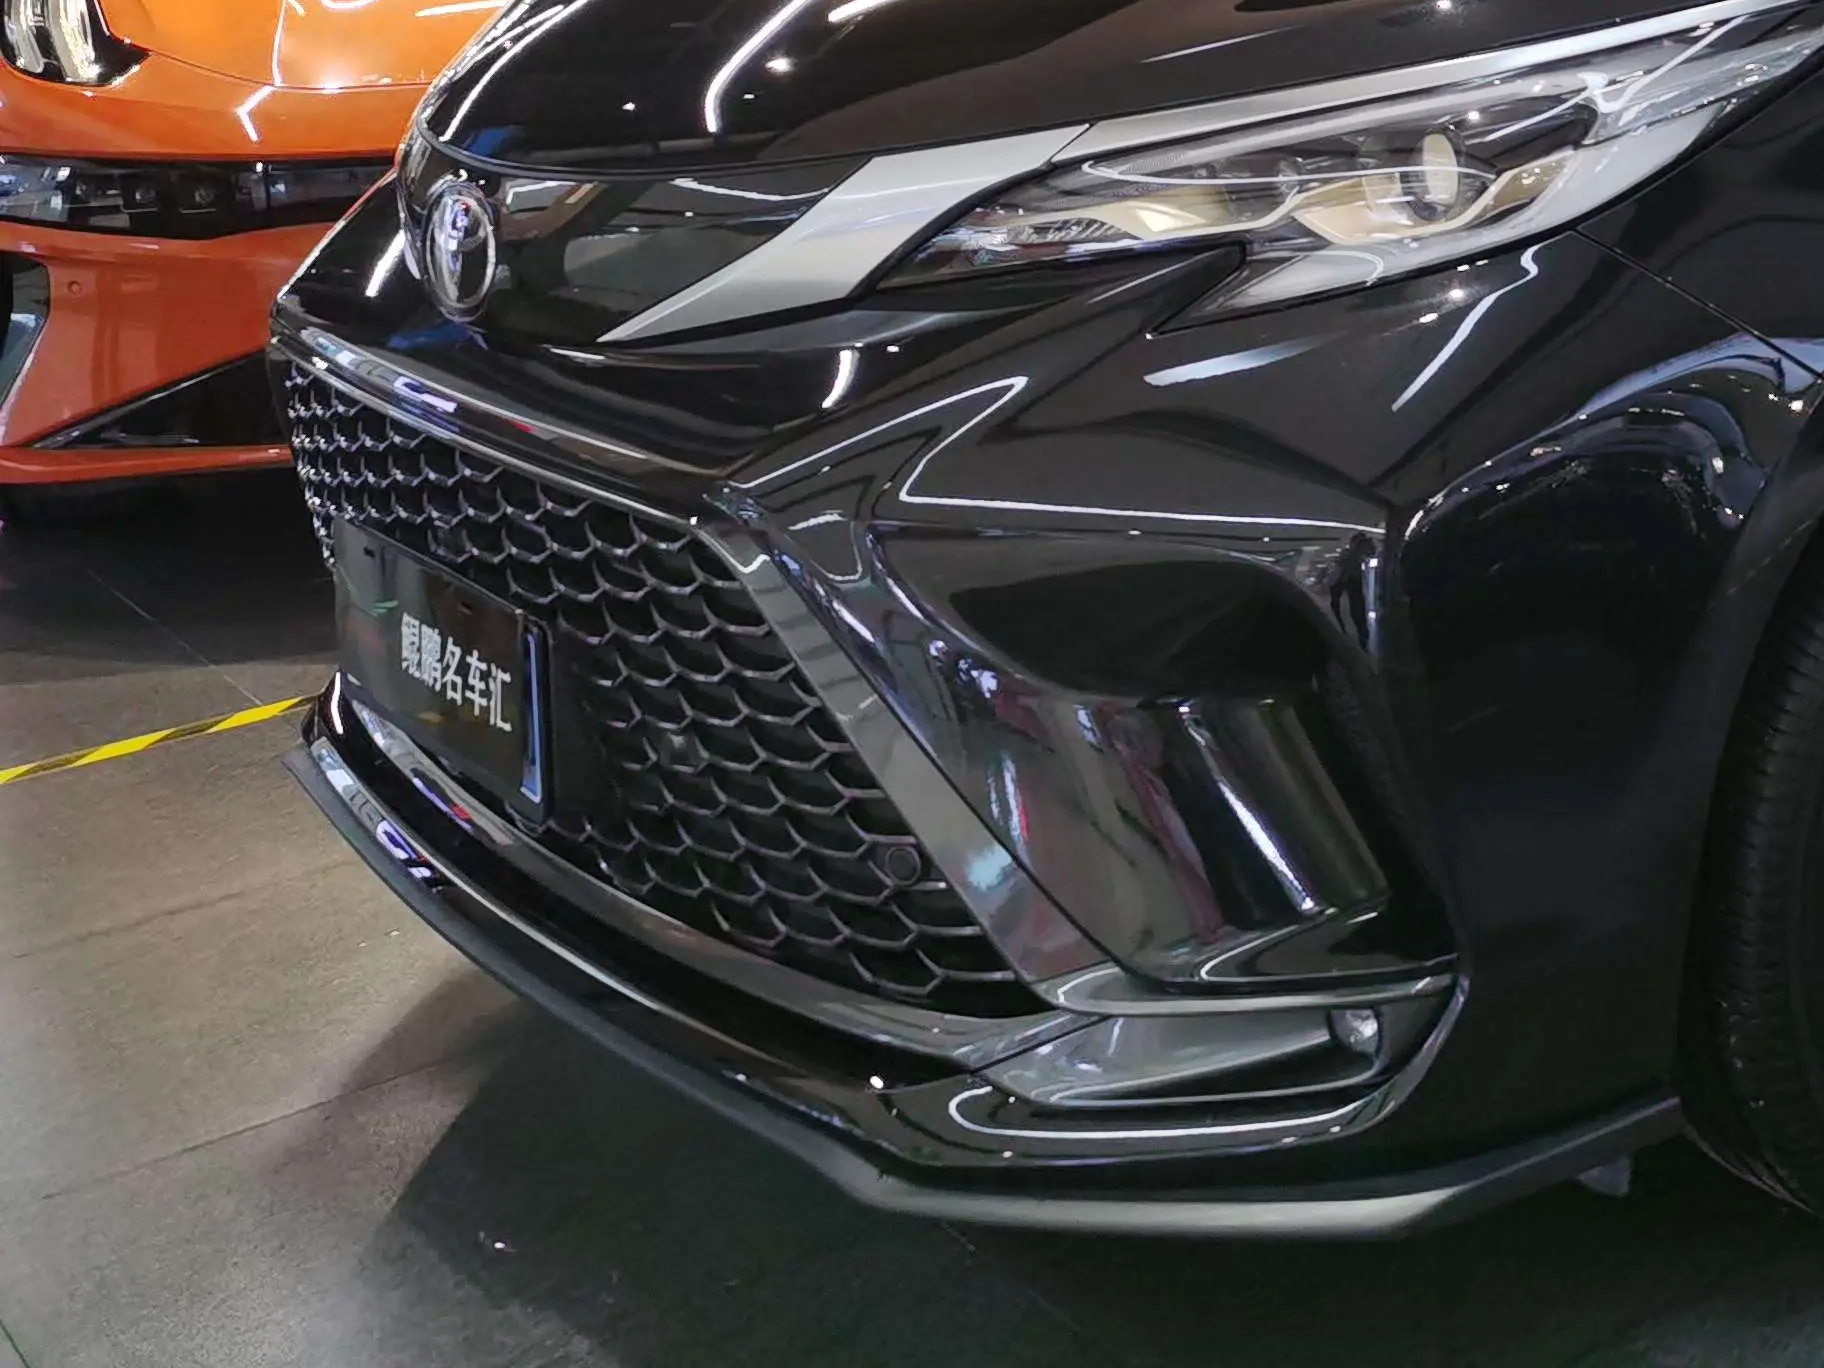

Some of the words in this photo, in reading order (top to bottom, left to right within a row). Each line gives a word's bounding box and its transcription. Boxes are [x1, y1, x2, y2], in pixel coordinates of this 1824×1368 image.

[400, 611, 513, 733] 鲲鹏名车汇
